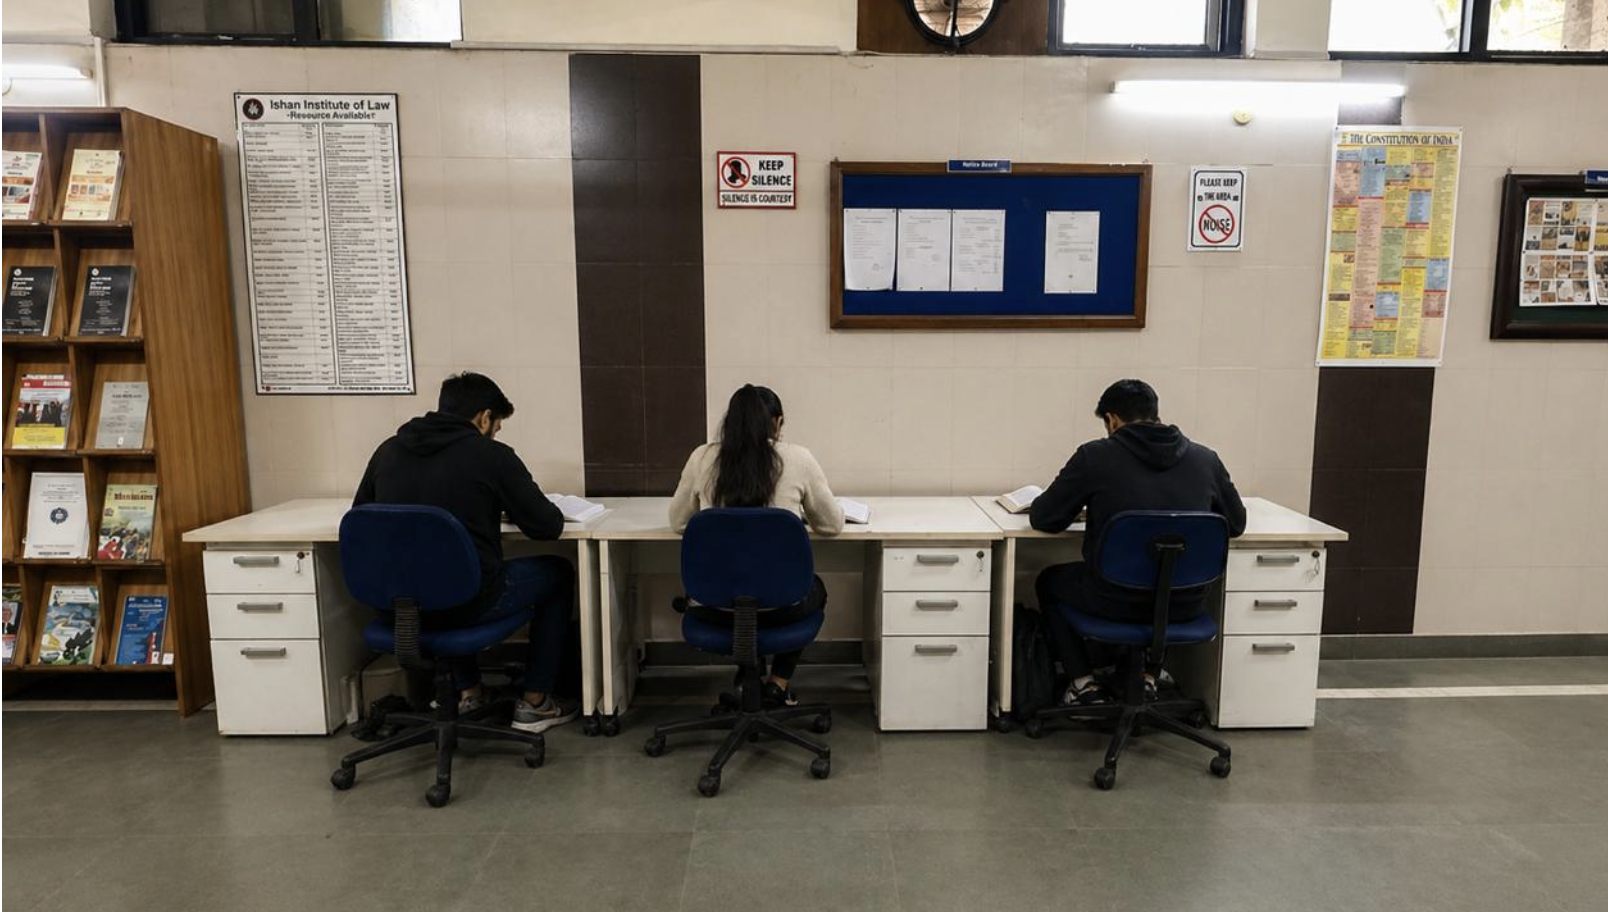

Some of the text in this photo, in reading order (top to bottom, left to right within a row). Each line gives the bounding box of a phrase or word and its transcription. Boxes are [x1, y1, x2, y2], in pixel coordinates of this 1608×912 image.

[270, 99, 391, 110] Ishan Institute of Law
[758, 160, 784, 171] KEEP
[752, 175, 792, 186] SILENCE
[1199, 178, 1238, 187] PLEASE KEEP
